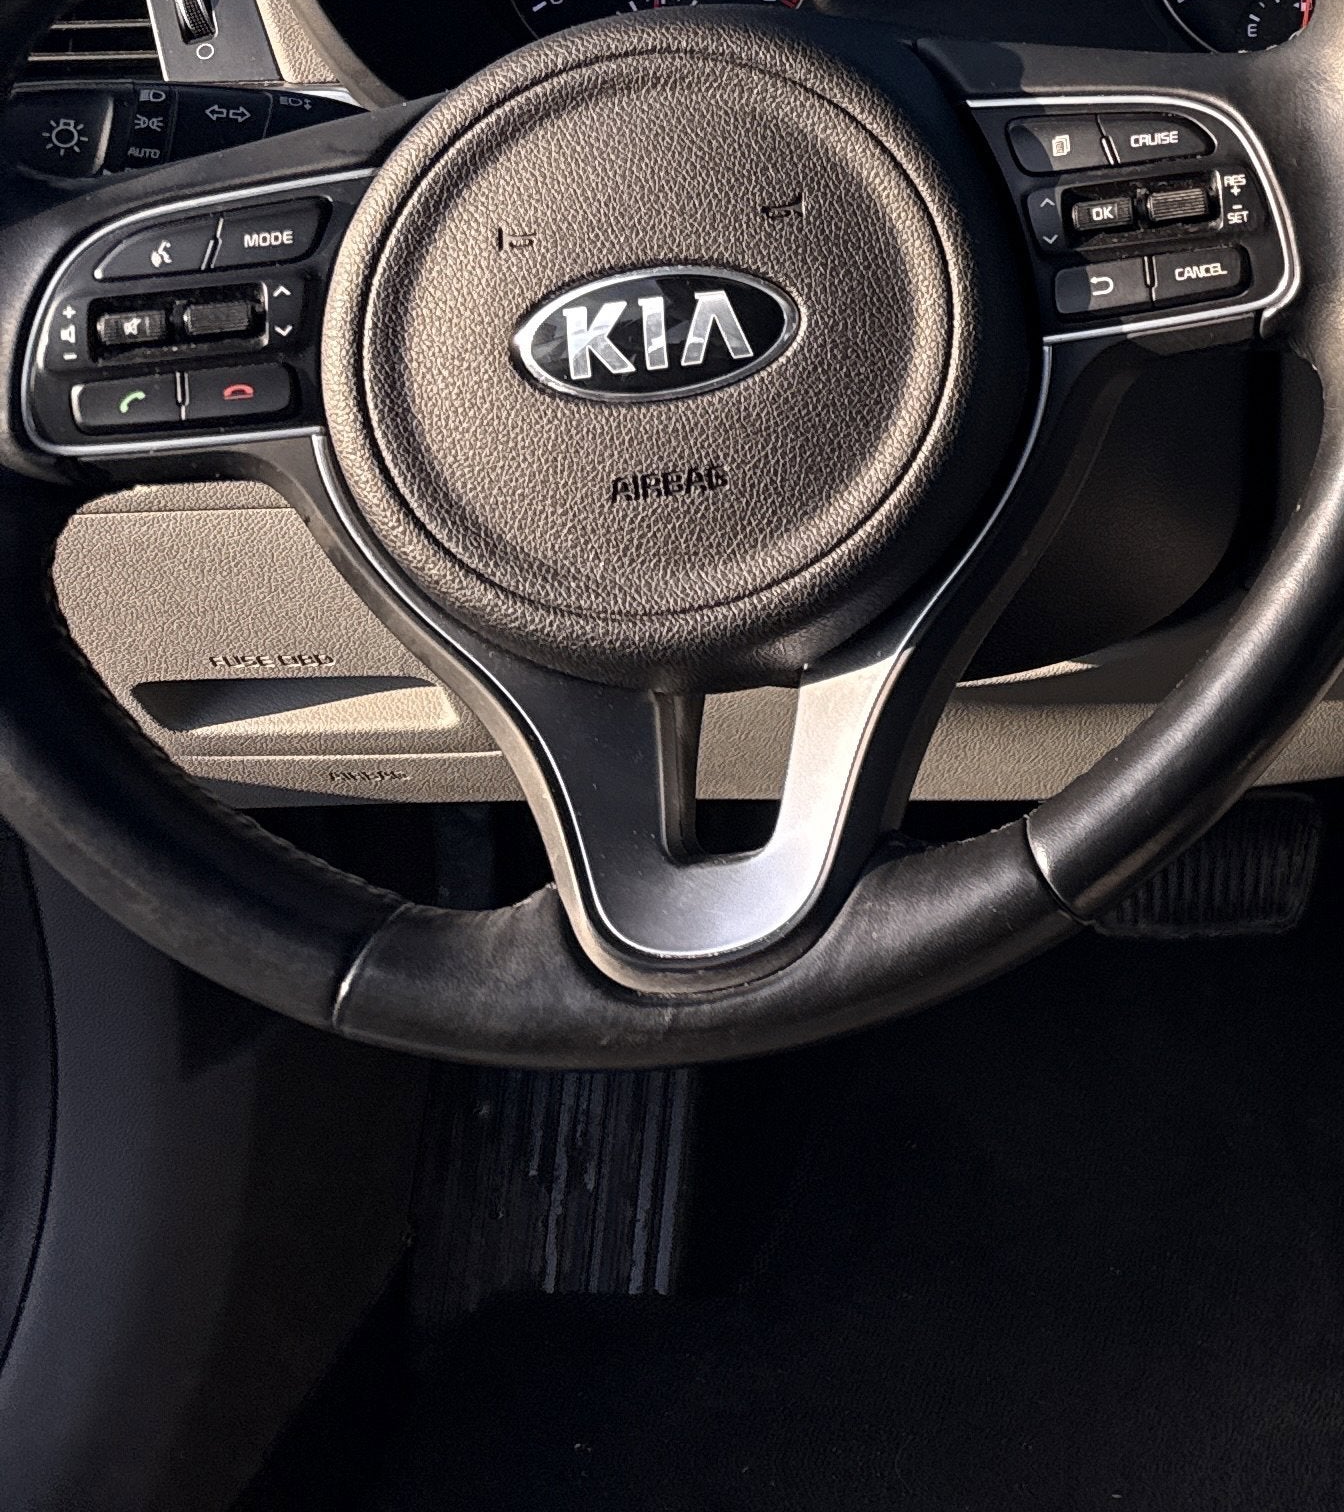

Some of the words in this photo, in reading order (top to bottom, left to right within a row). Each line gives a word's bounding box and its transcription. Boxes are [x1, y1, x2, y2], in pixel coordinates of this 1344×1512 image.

[1247, 23, 1258, 38] E
[1130, 131, 1179, 148] CRUISE
[127, 146, 161, 160] AUTO
[1223, 174, 1247, 187] RES
[1091, 206, 1115, 221] OK
[1226, 210, 1250, 225] SET
[243, 229, 294, 248] MODE
[1174, 263, 1228, 282] CANCEL
[562, 290, 754, 380] KIA
[611, 464, 729, 503] AIRBAG
[208, 654, 276, 669] FUSE
